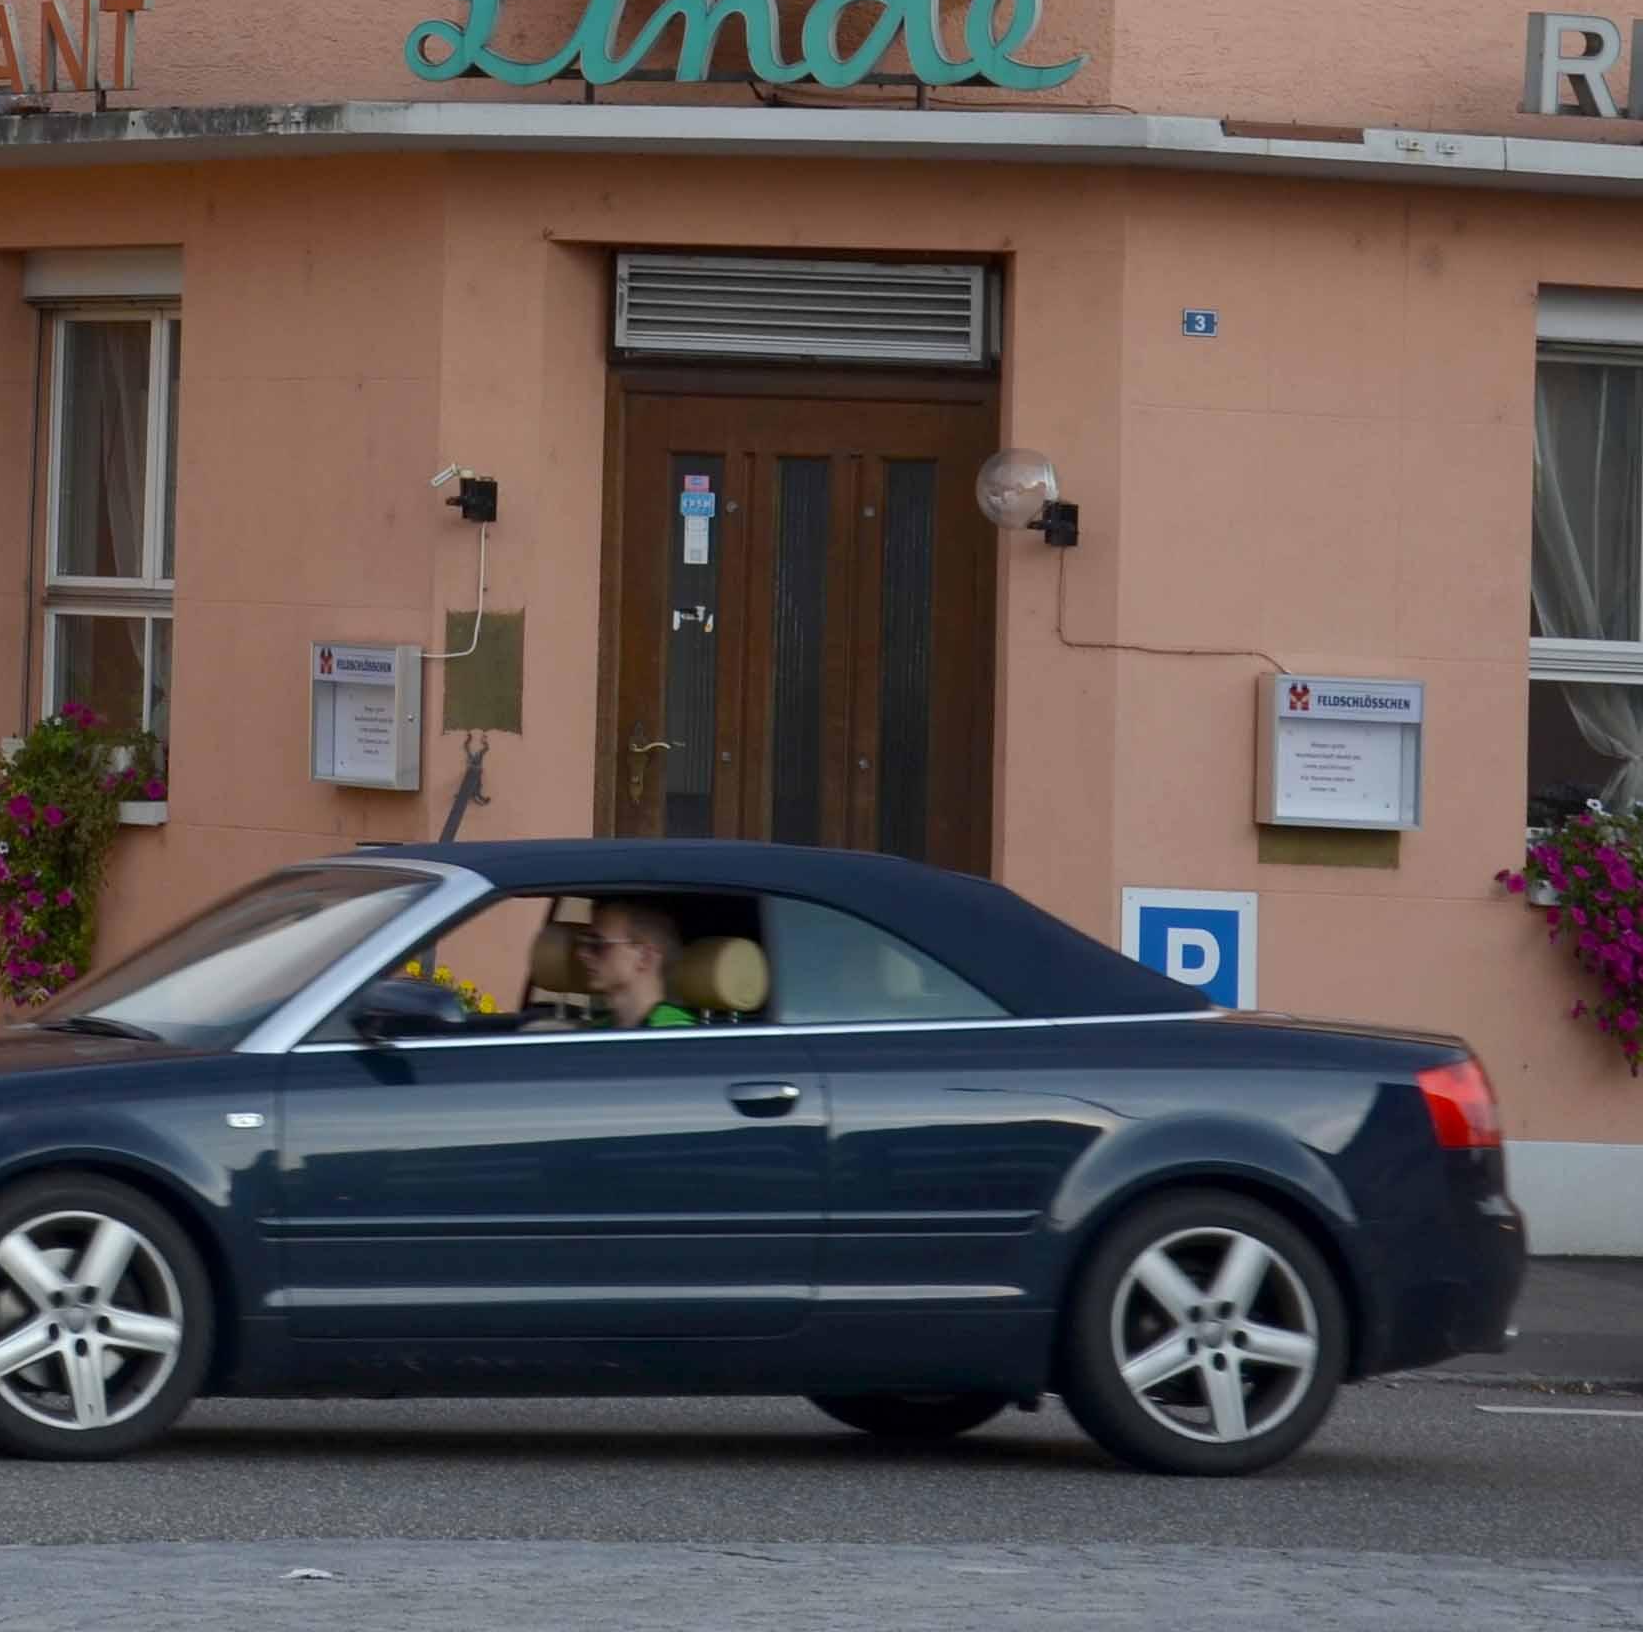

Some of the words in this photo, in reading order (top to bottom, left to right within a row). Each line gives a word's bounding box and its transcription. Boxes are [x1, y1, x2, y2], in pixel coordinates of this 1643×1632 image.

[1194, 314, 1206, 332] 3
[1317, 694, 1411, 711] FELDSCHLÖSSCHEN
[1167, 927, 1221, 985] P
